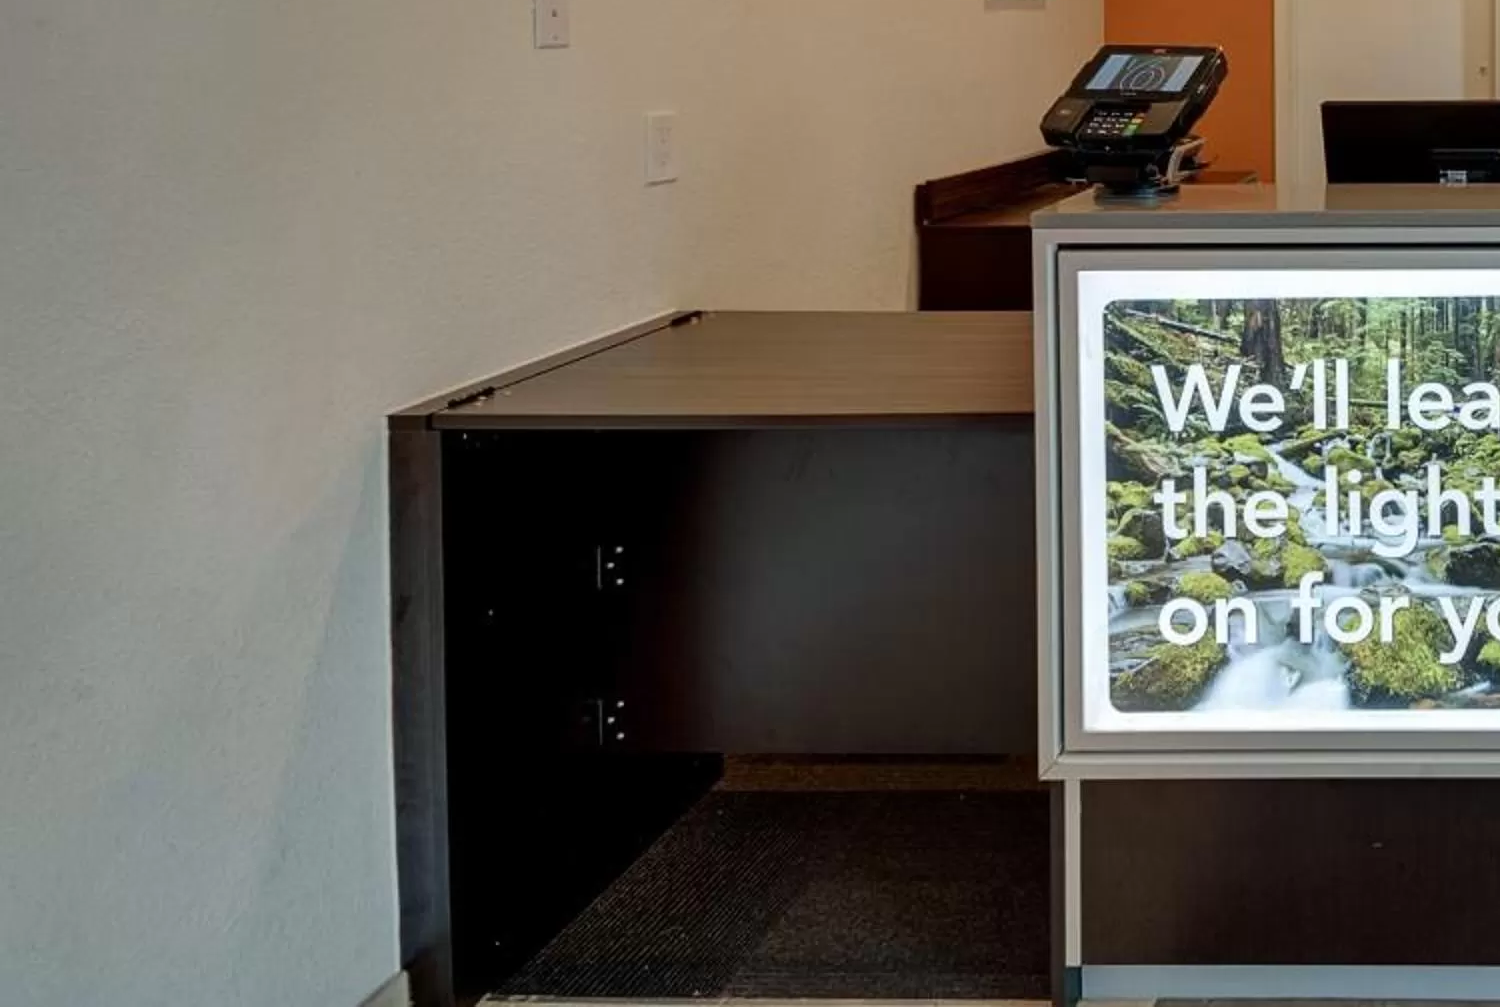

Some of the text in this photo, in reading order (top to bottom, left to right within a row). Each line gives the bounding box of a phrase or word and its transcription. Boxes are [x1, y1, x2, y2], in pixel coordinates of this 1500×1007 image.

[1154, 466, 1288, 538] the
[1158, 595, 1256, 645] on
[1291, 571, 1411, 644] for
